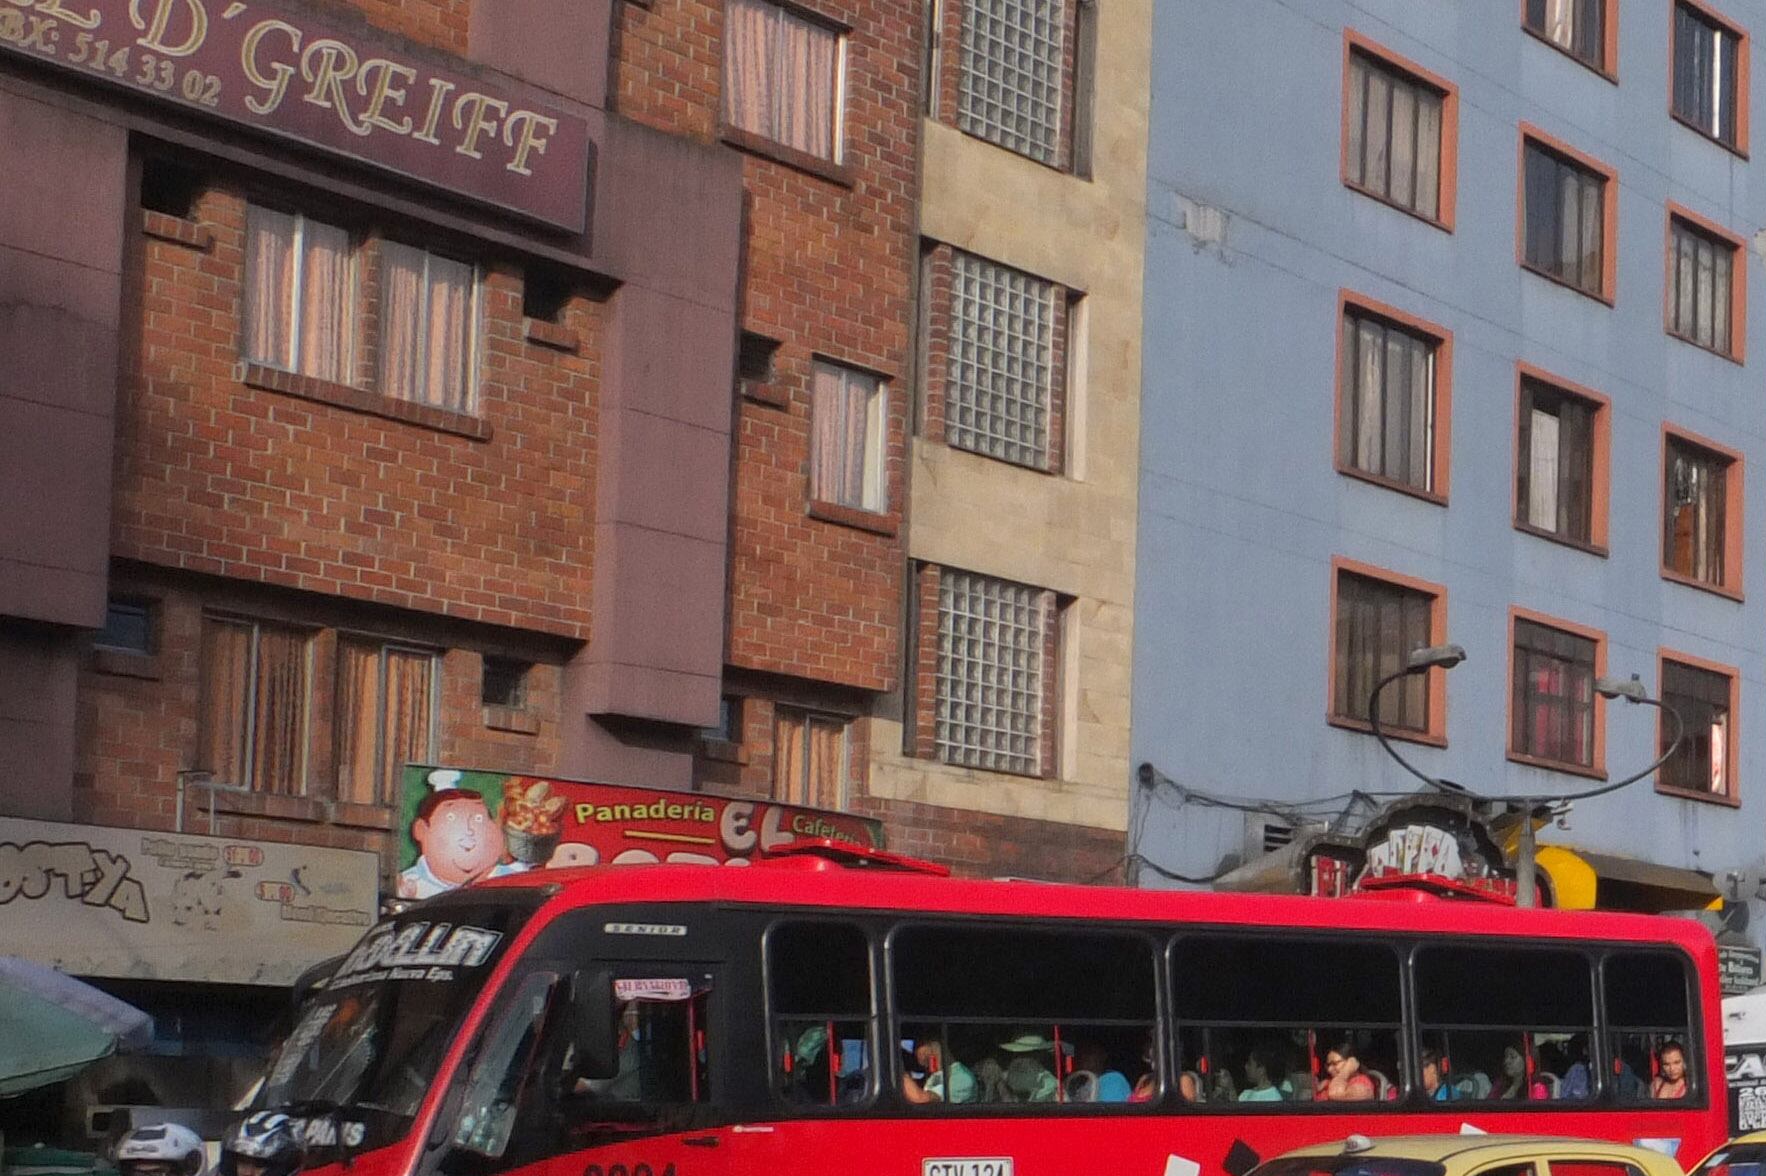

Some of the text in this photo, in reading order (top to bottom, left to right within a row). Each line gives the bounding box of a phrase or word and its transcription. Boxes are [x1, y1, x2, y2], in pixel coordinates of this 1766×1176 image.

[0, 8, 60, 54] BX:
[67, 32, 131, 77] 514
[135, 54, 176, 91] 33
[182, 69, 222, 107] 02
[575, 799, 716, 824] Panadería
[719, 801, 795, 850] EL
